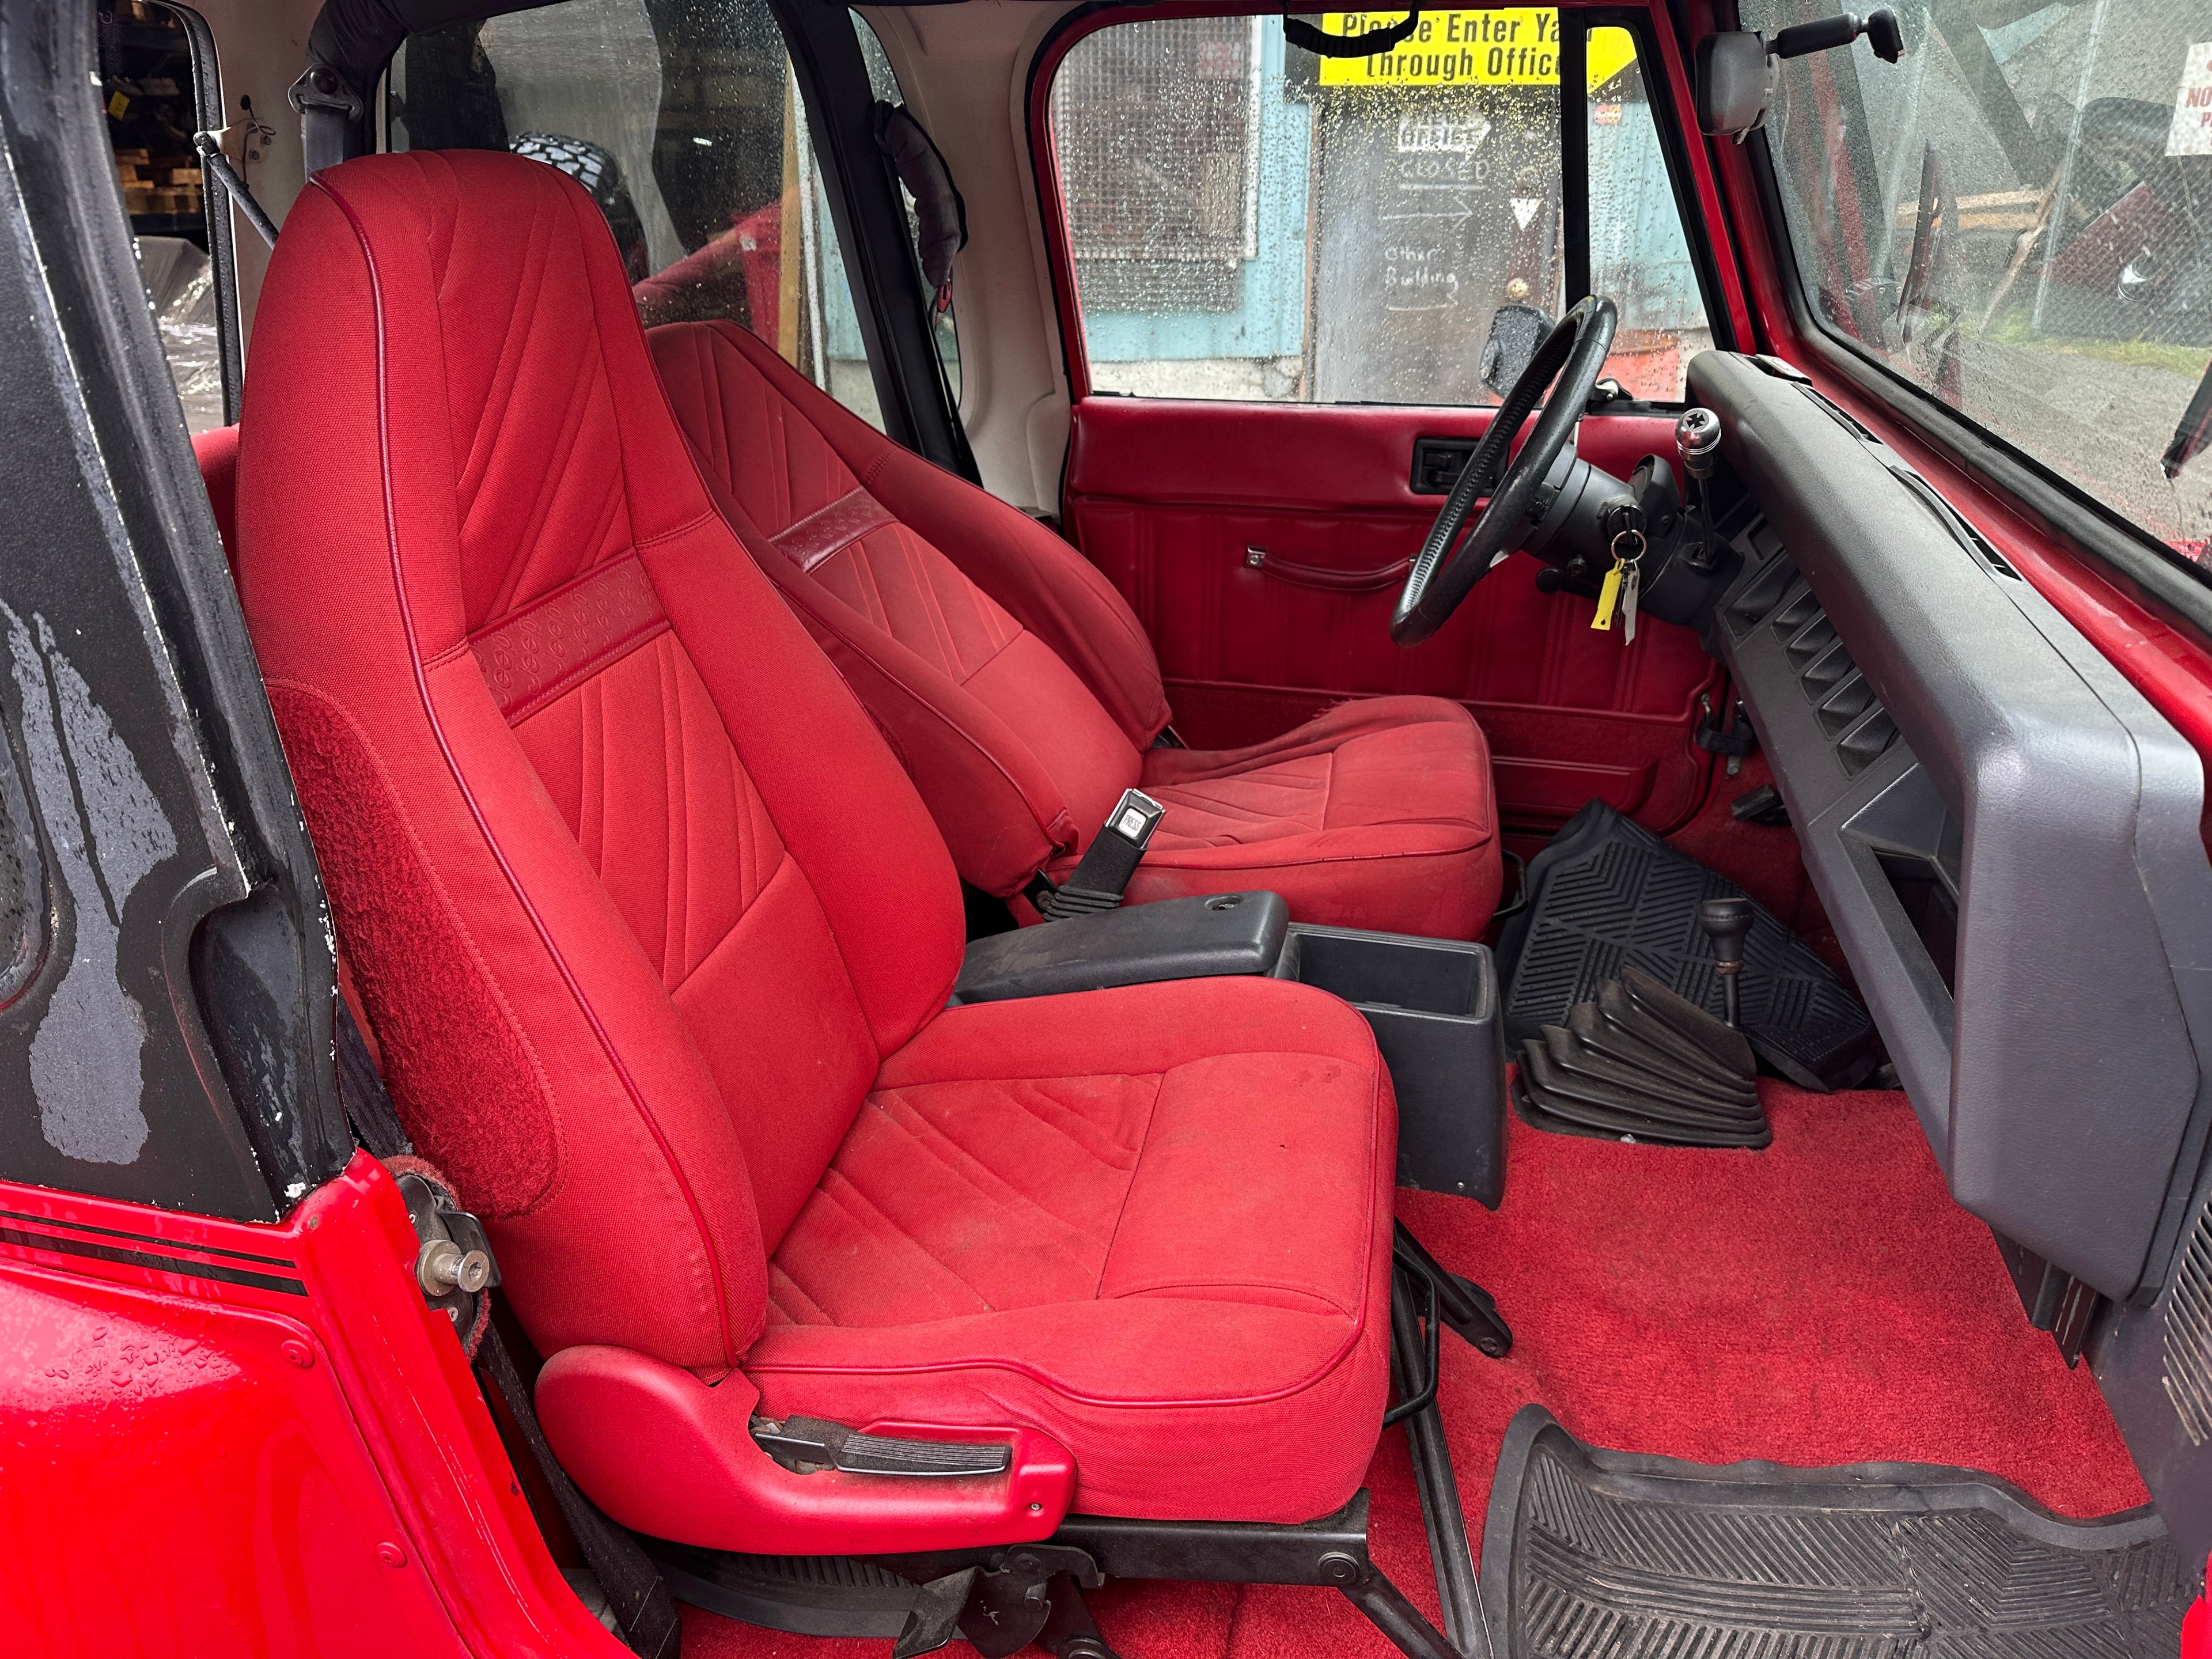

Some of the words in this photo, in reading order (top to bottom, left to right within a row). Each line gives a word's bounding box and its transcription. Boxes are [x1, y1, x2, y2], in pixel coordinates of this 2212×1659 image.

[1447, 13, 1521, 43] Enter
[517, 618, 540, 694] Jeep
[543, 603, 566, 679] Jeep
[1123, 814, 1142, 831] PRESS
